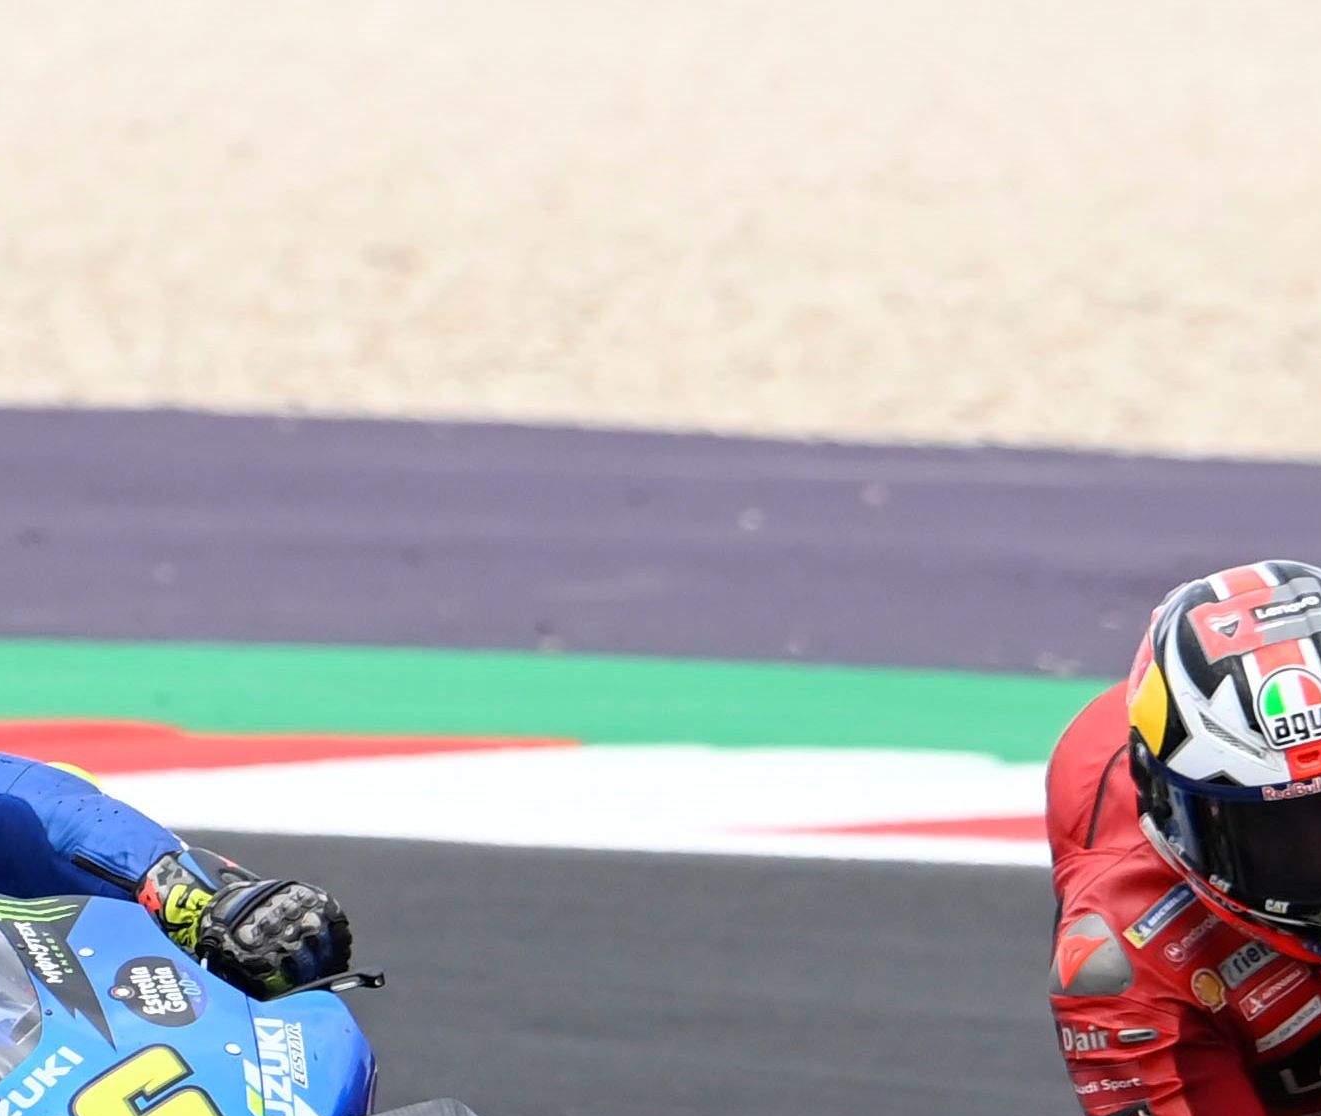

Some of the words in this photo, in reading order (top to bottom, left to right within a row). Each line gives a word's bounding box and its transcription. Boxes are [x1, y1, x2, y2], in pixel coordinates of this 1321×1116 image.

[1255, 595, 1321, 620] Lenovo
[1265, 899, 1289, 914] CAT
[1101, 1076, 1143, 1096] Sport
